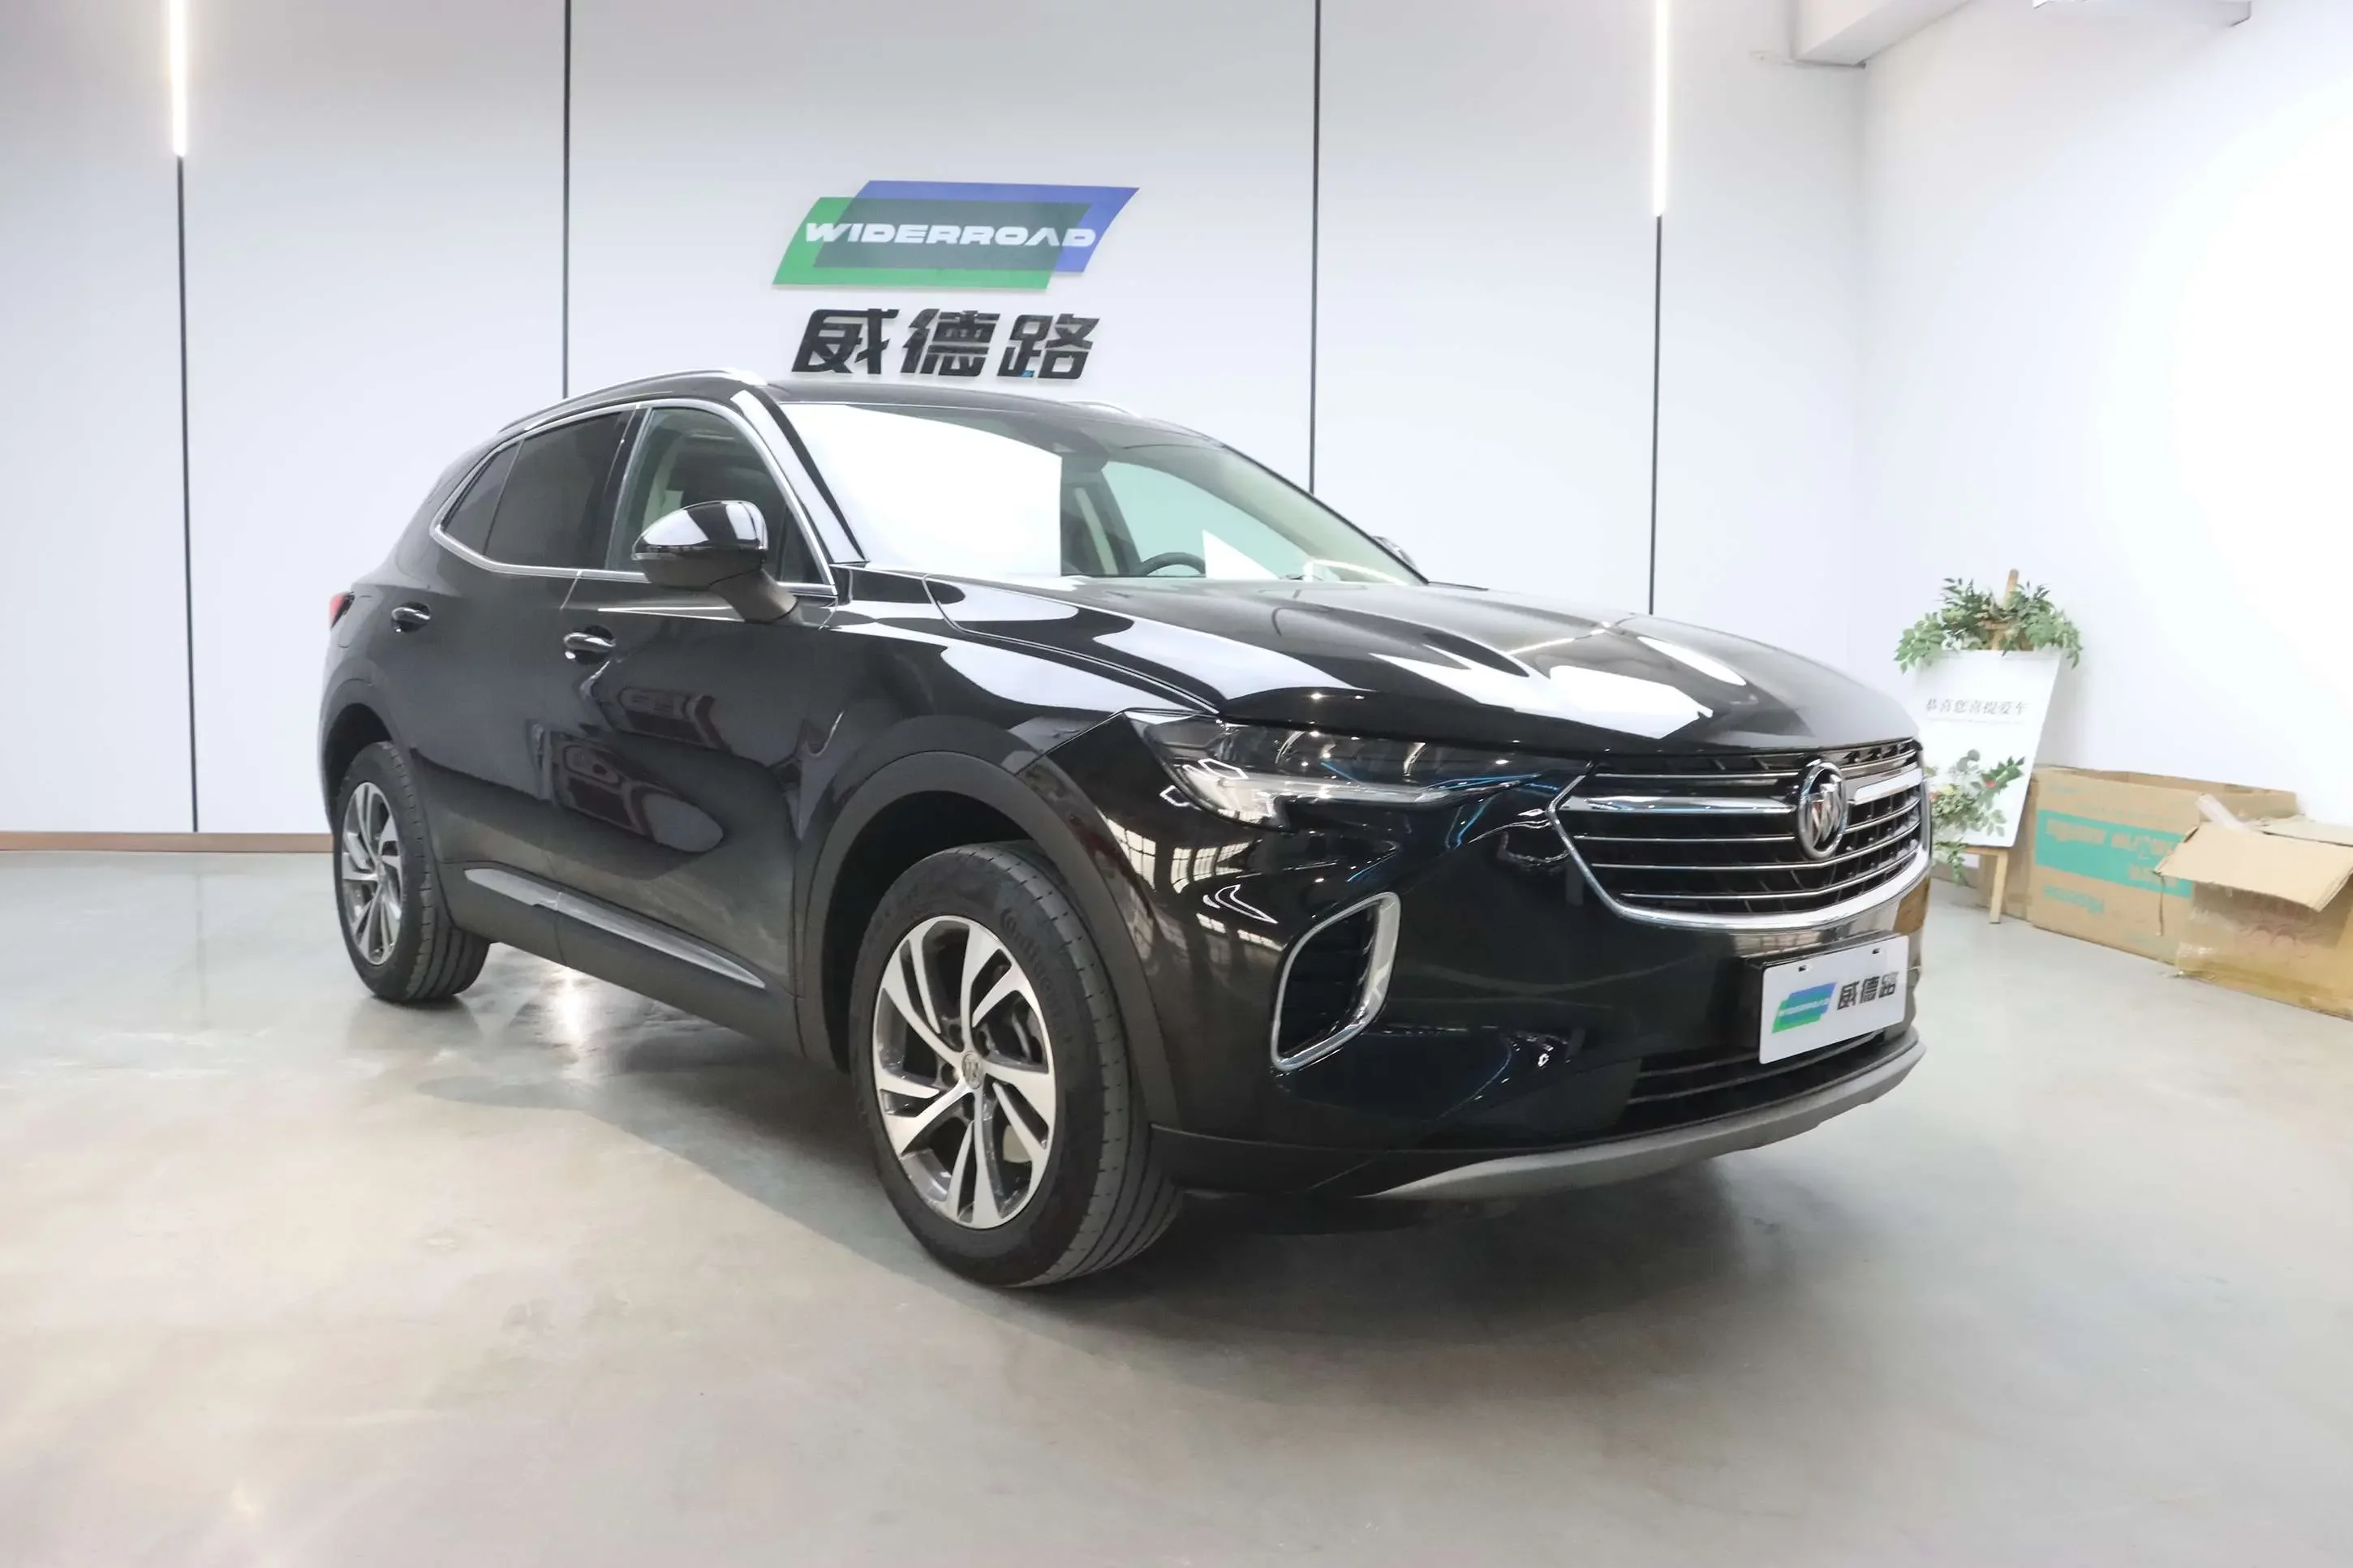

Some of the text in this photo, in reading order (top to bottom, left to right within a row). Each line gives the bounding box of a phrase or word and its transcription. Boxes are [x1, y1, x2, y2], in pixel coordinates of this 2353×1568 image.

[806, 222, 1096, 248] WIDERROAD
[791, 308, 1100, 380] 威德路
[1836, 971, 1899, 1011] 威德路
